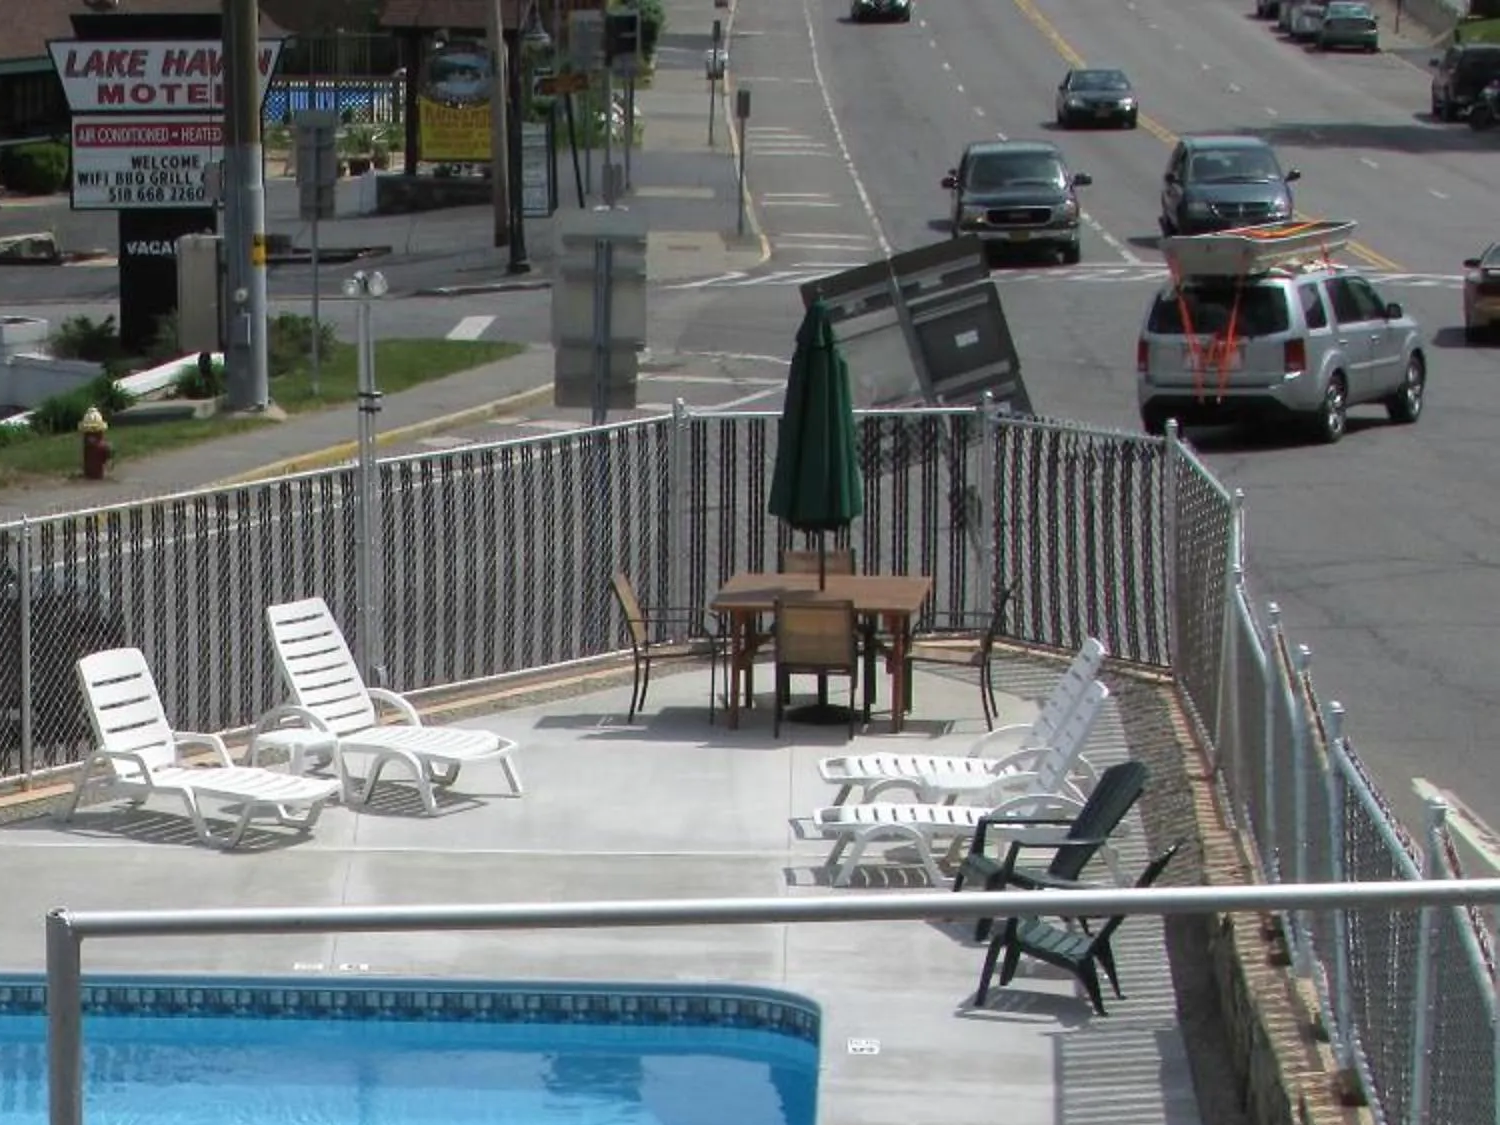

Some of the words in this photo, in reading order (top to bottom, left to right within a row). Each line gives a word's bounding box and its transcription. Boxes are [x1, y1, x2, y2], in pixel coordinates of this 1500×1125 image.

[65, 49, 148, 78] LAKE
[161, 48, 273, 77] HAVN
[97, 83, 225, 105] MOTEL
[78, 128, 95, 142] AIR
[97, 127, 169, 142] CONDITIONED
[181, 127, 222, 142] HEATED
[131, 155, 199, 170] WELCOME
[78, 172, 109, 186] WIFI
[150, 172, 192, 186] GRILL
[137, 187, 165, 202] 668
[171, 187, 204, 202] 2260
[127, 240, 178, 256] VACA
